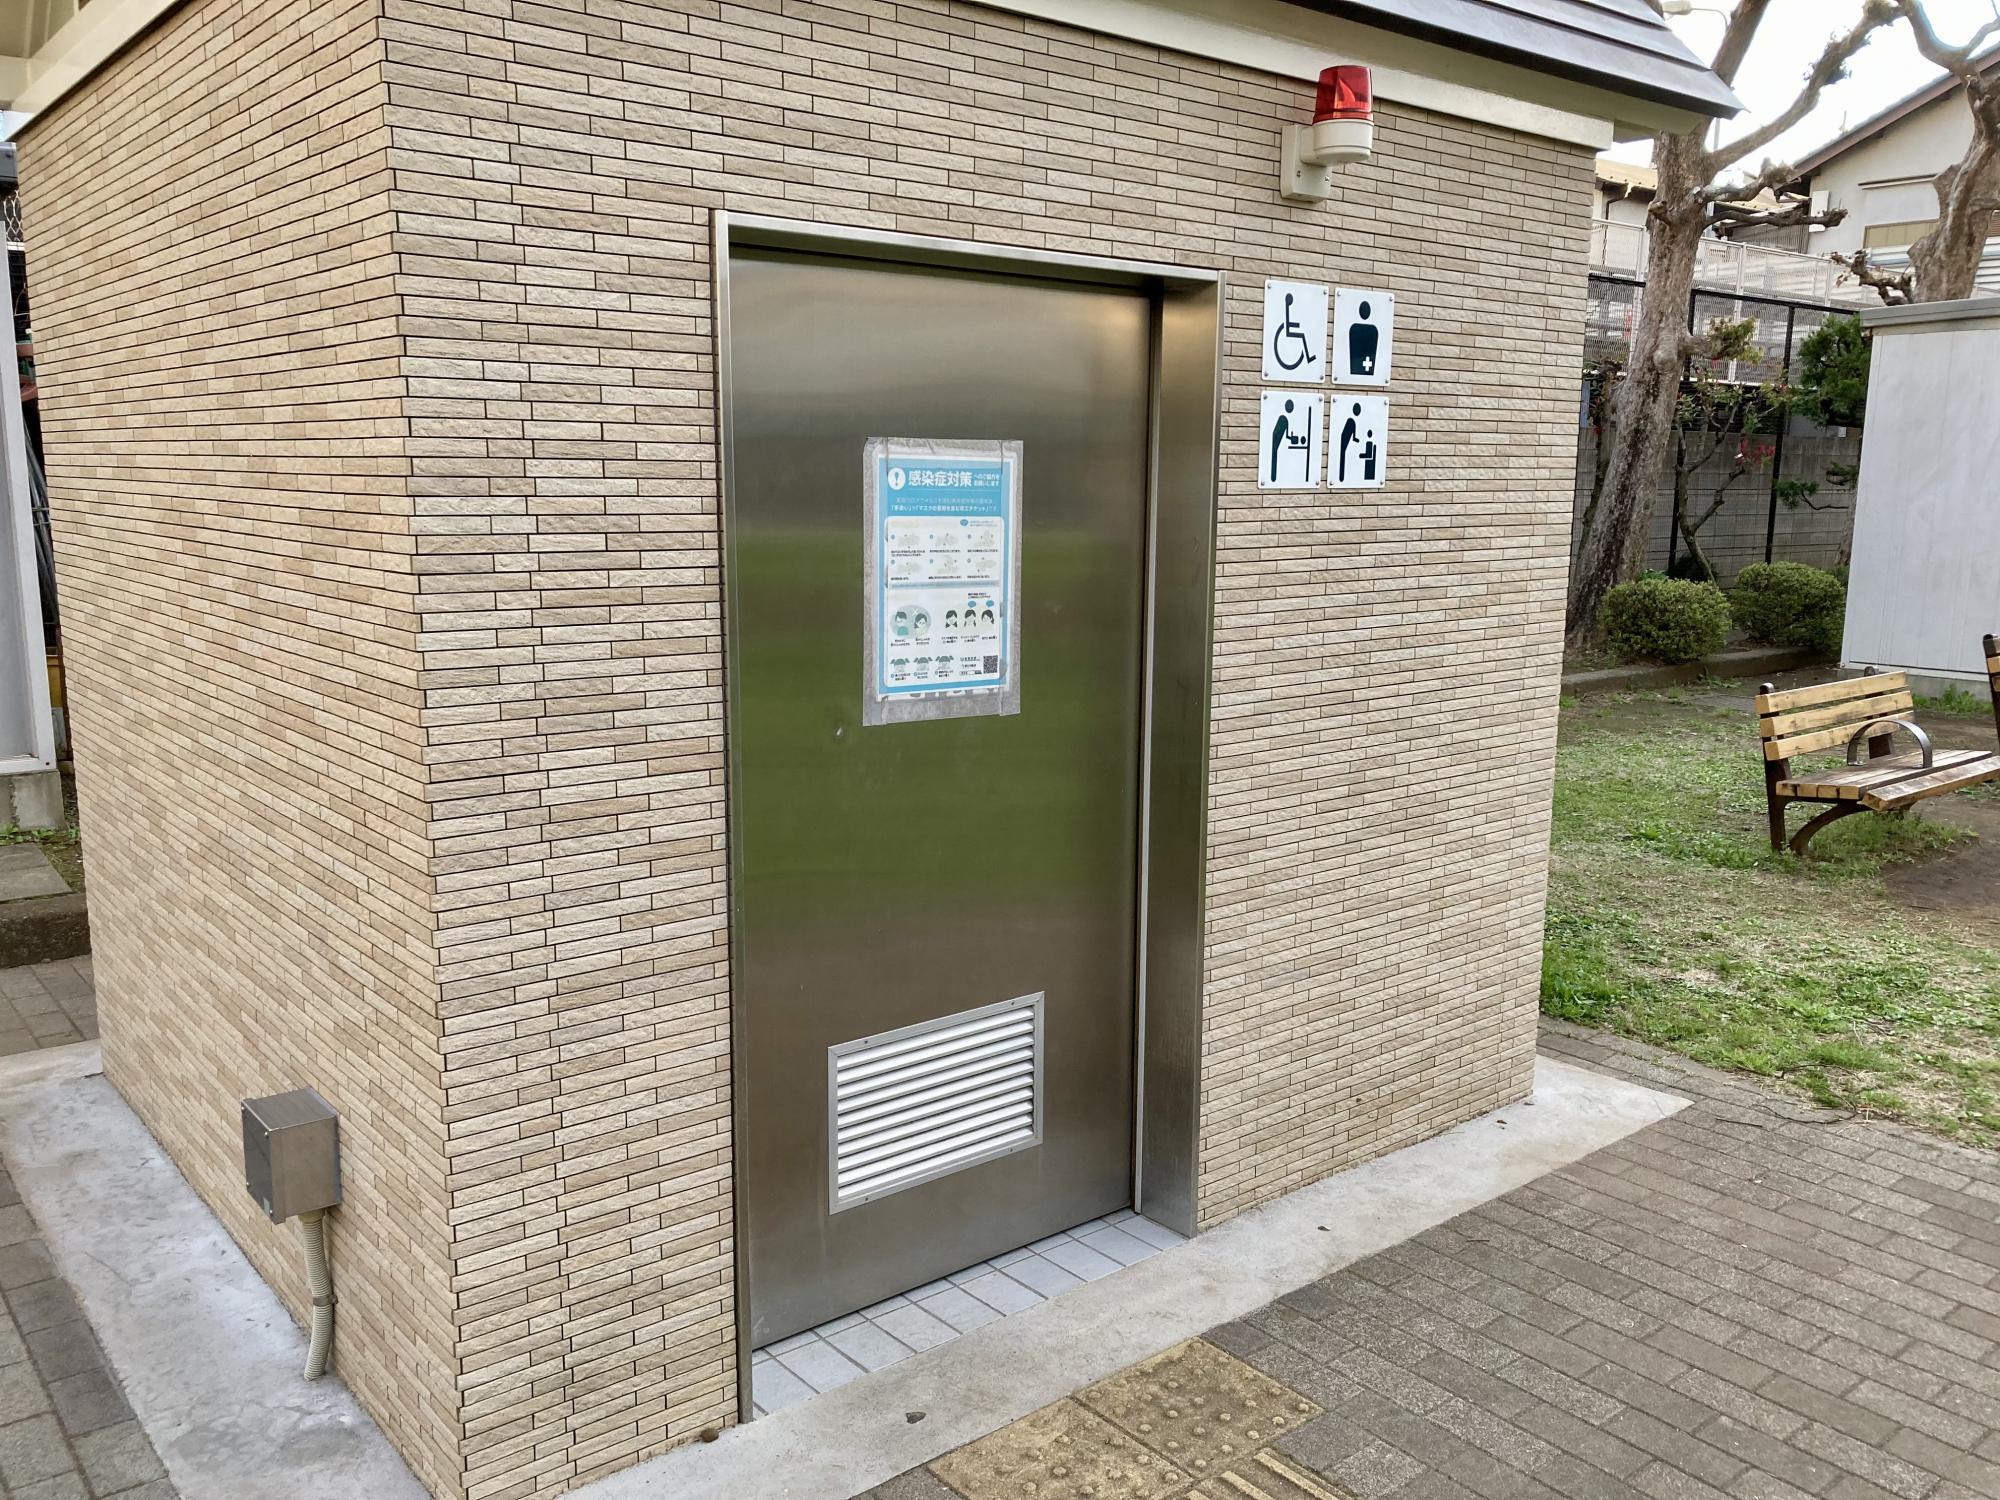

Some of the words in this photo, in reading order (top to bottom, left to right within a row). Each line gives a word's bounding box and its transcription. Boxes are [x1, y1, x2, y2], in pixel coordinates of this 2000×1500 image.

[908, 470, 972, 487] 感染症対策
